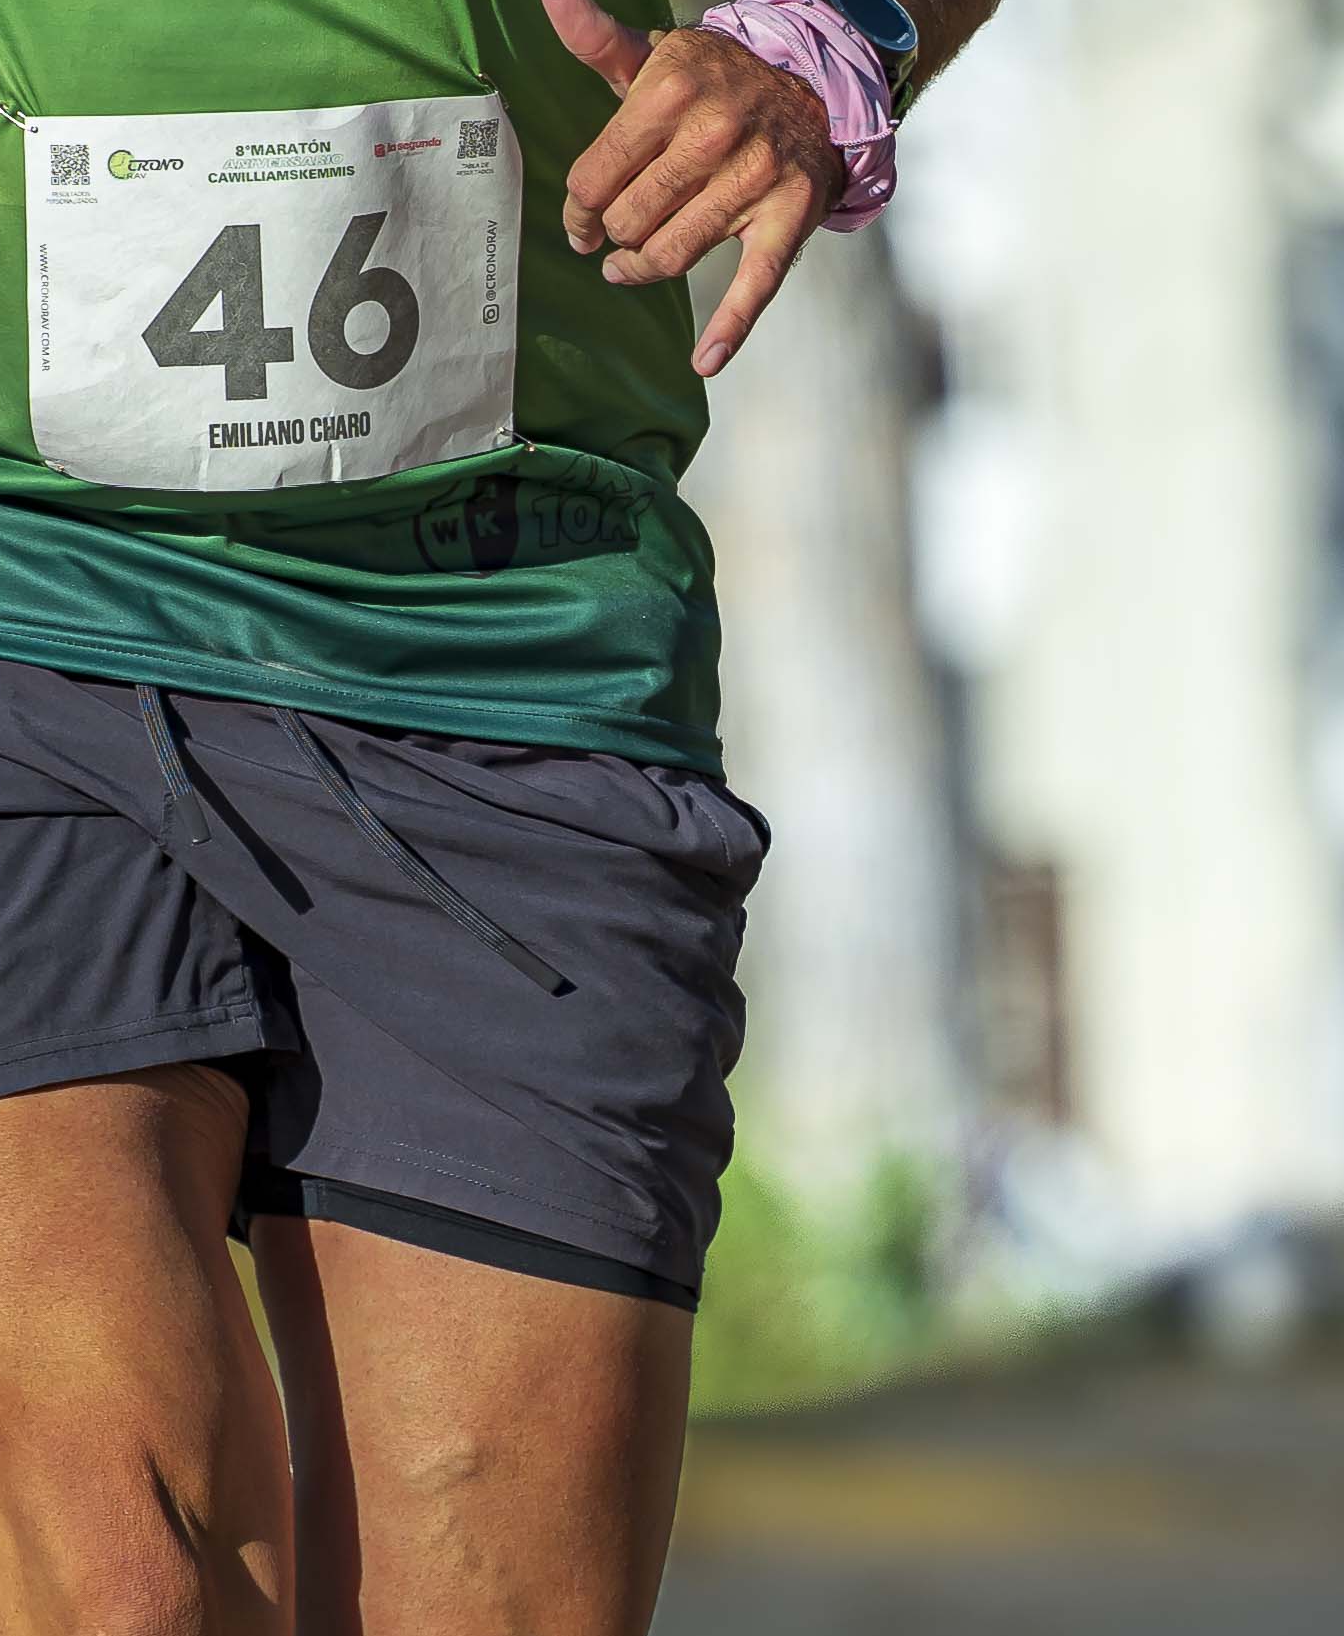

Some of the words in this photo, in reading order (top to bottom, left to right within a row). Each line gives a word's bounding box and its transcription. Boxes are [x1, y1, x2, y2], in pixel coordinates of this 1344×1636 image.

[208, 166, 356, 183] CAWILLIAMSKEMMIS
[486, 220, 498, 301] @CRONORAV
[141, 211, 420, 401] 46
[209, 419, 305, 449] EMILIANO
[310, 411, 371, 443] CHARO
